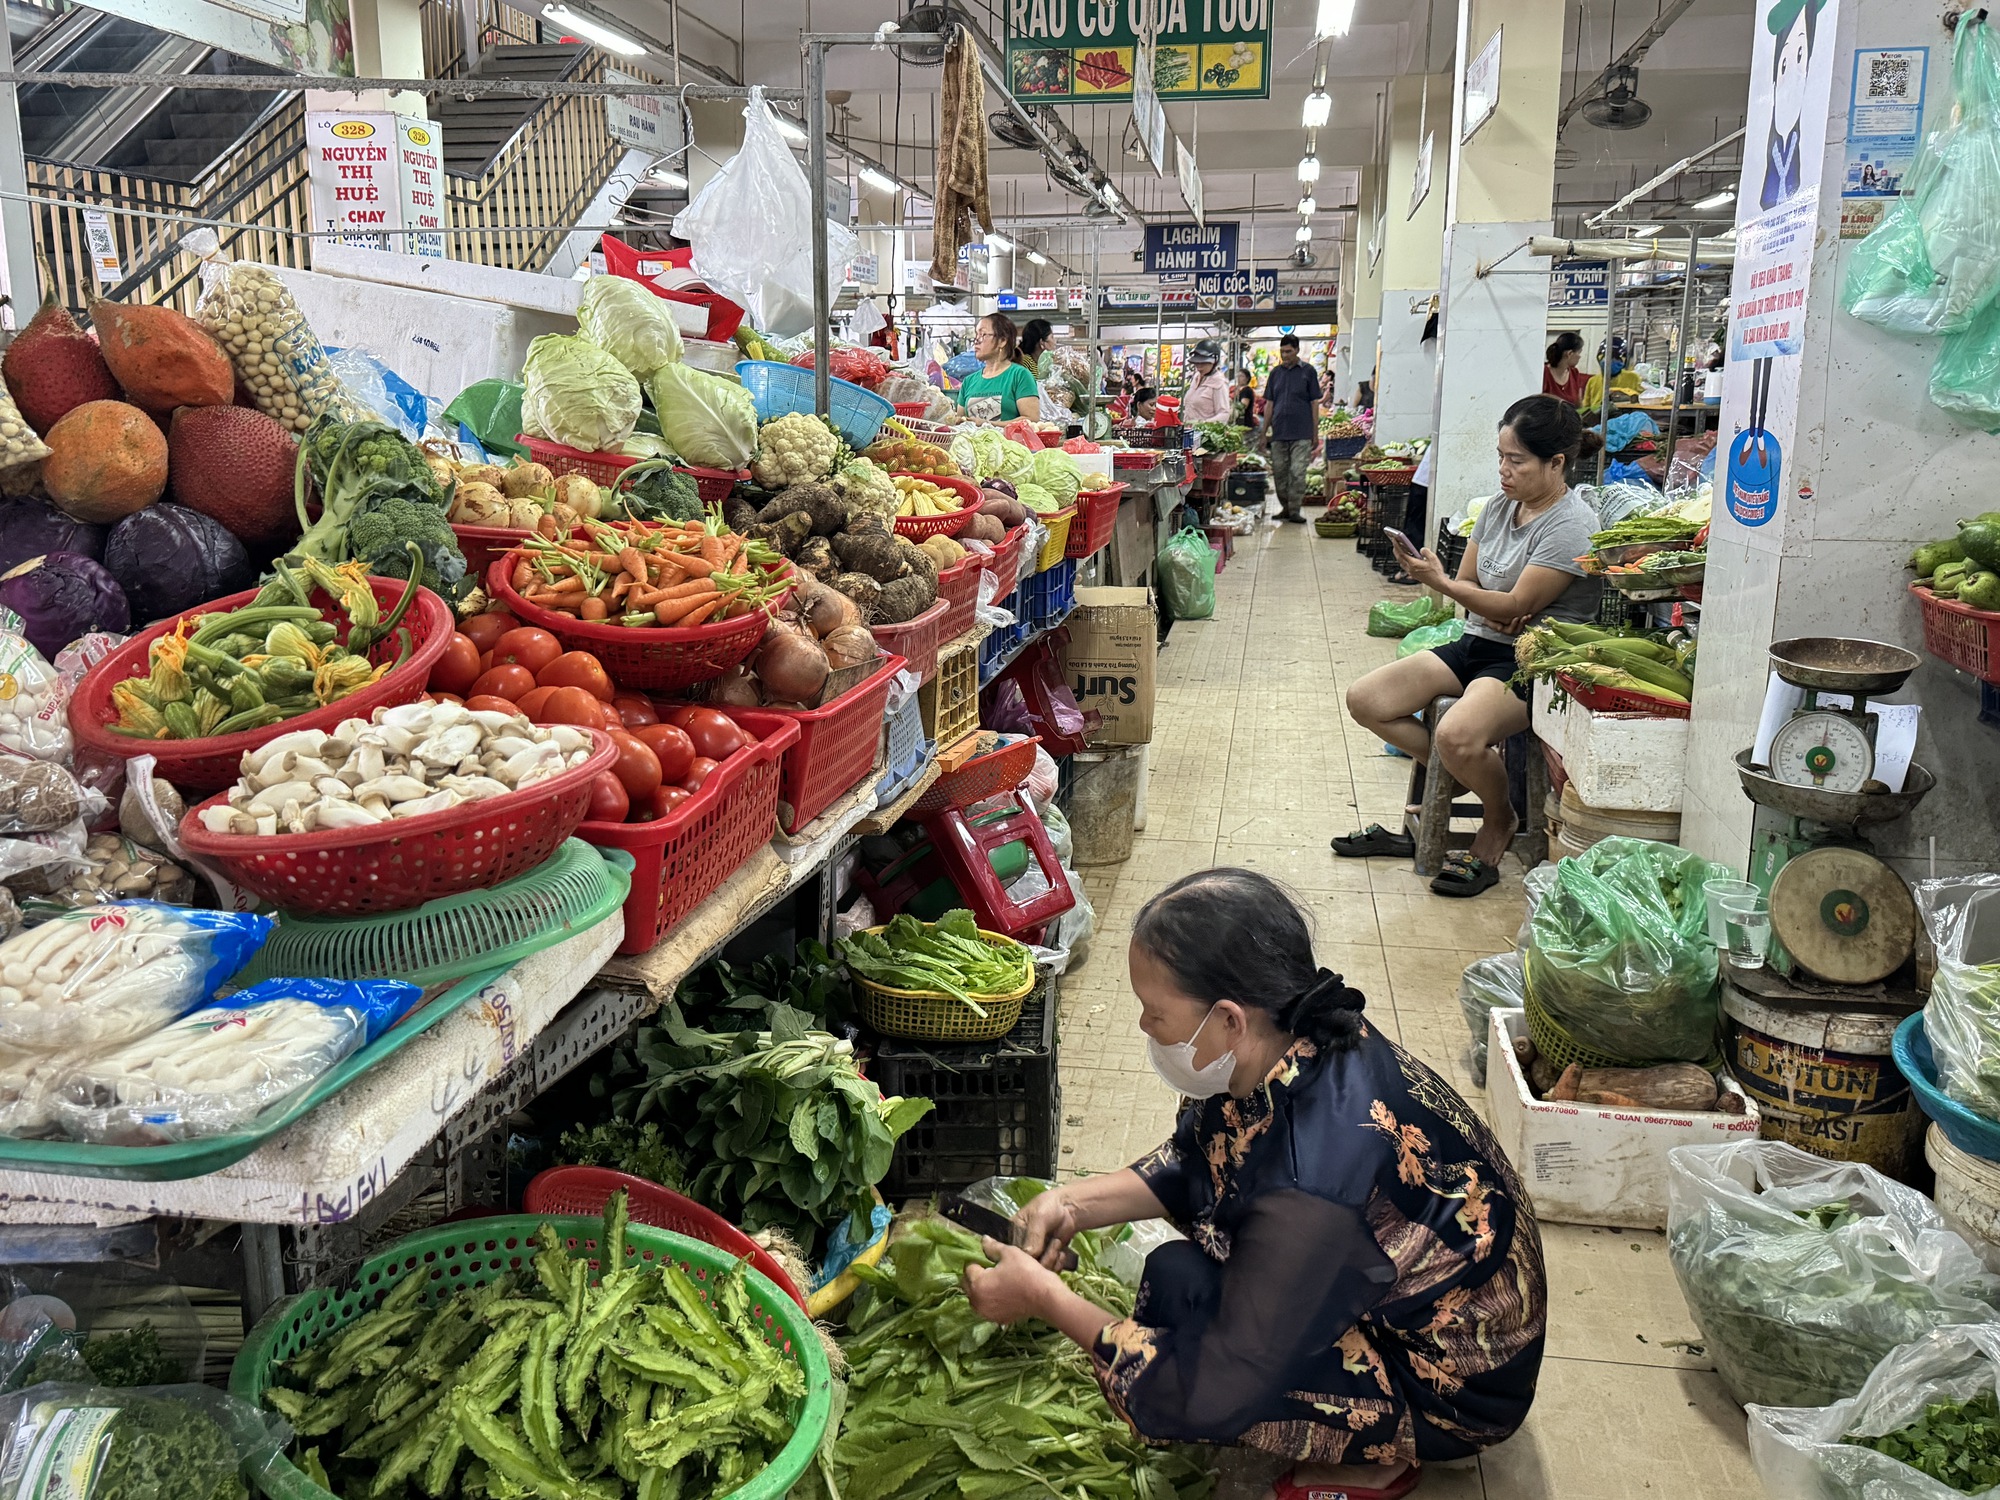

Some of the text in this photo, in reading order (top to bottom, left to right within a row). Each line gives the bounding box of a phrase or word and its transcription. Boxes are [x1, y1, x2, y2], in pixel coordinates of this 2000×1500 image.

[341, 125, 366, 136] 328
[413, 131, 426, 143] 328
[322, 141, 387, 161] NGUYỄN
[338, 165, 373, 182] THỊ
[412, 169, 432, 188] THỊ
[335, 183, 379, 204] HUỆ
[411, 190, 435, 210] HUỆ
[348, 211, 386, 223] CHAY
[419, 214, 439, 229] CHAY
[1163, 227, 1220, 245] LAGHIM
[1155, 245, 1227, 268] HÀNH TỎI
[1199, 273, 1221, 293] NGŨ
[1253, 276, 1274, 297] GẠO
[1297, 285, 1337, 297] Khánh
[1072, 674, 1137, 705] Surf
[1763, 1057, 1872, 1095] JOTUN
[1598, 1111, 1611, 1120] HE
[1614, 1114, 1641, 1123] QUAN
[1644, 1116, 1693, 1128] 0966770800
[1713, 1122, 1726, 1131] HE
